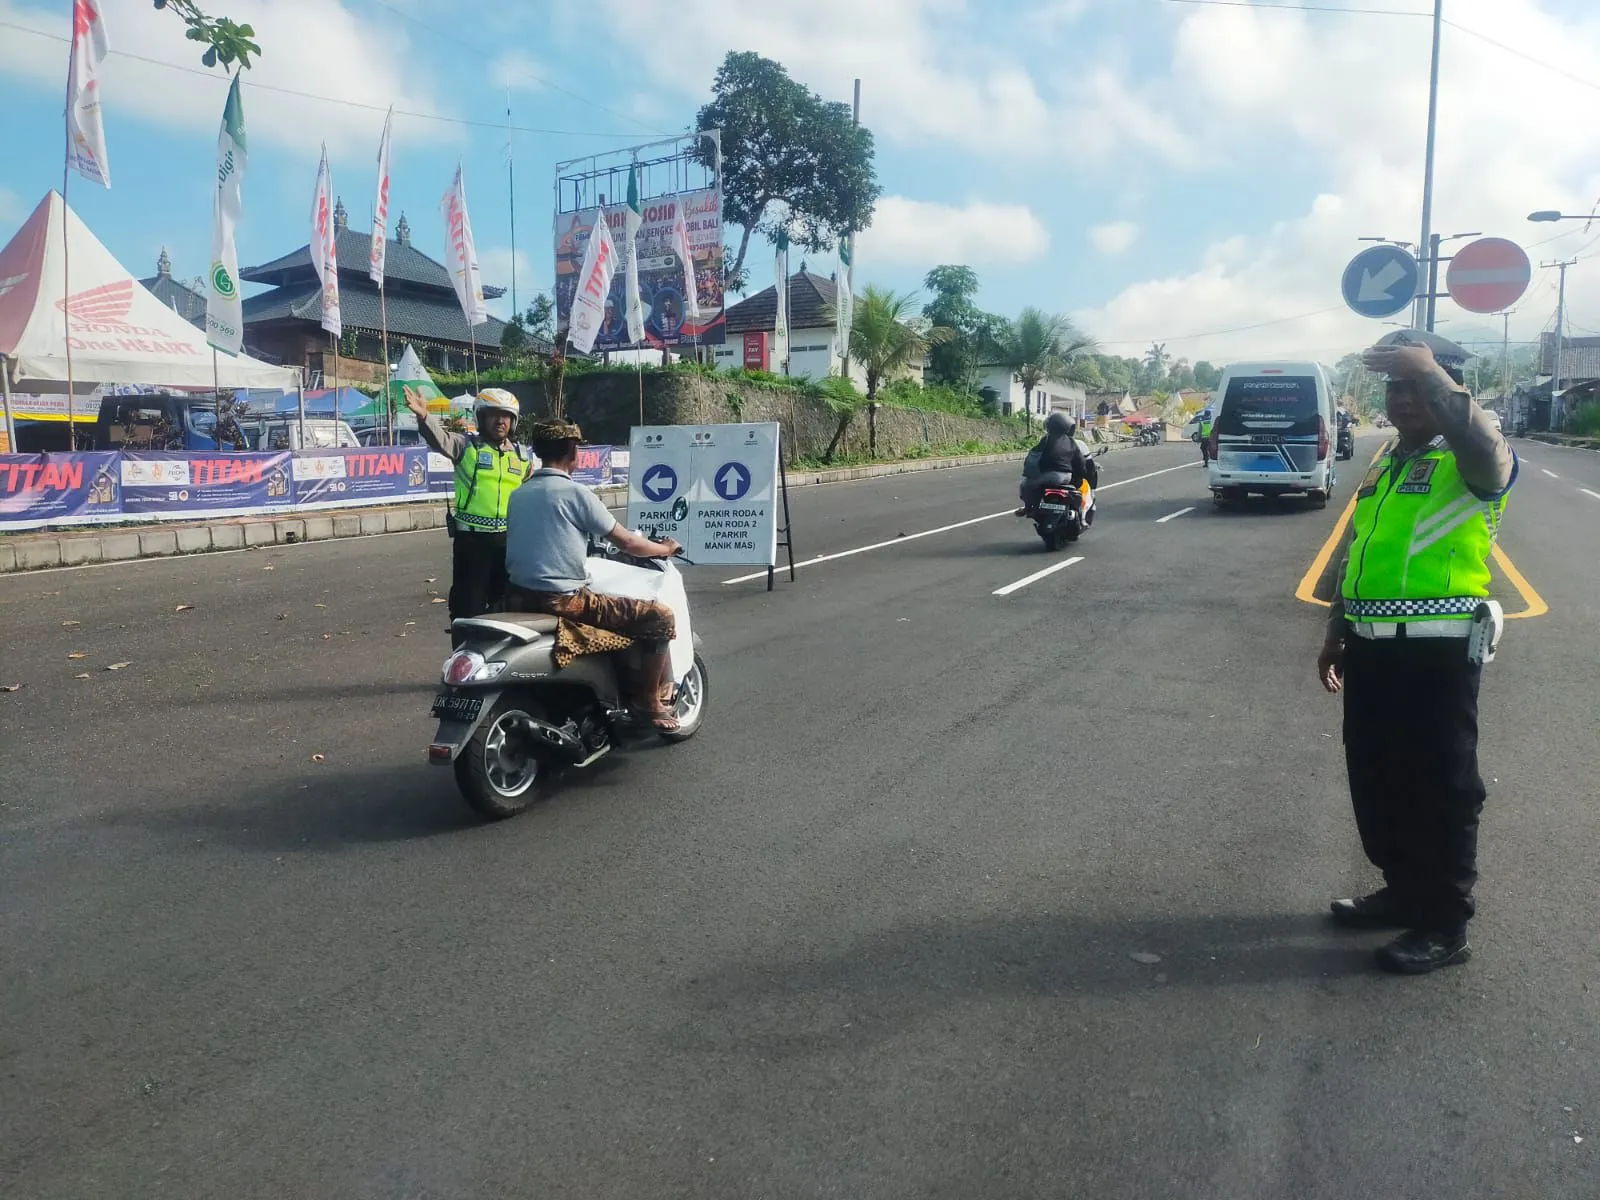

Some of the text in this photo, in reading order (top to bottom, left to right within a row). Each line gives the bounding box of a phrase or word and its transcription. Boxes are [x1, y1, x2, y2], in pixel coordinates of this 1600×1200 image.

[70, 323, 171, 338] HONDA
[345, 452, 405, 477] TITAN
[190, 459, 266, 486] TITAN
[698, 509, 764, 518] PARKIR RODA 4
[704, 520, 757, 529] DAN RODA 2
[712, 530, 748, 540] (PARKIR
[704, 541, 756, 551] MANIK MAS)
